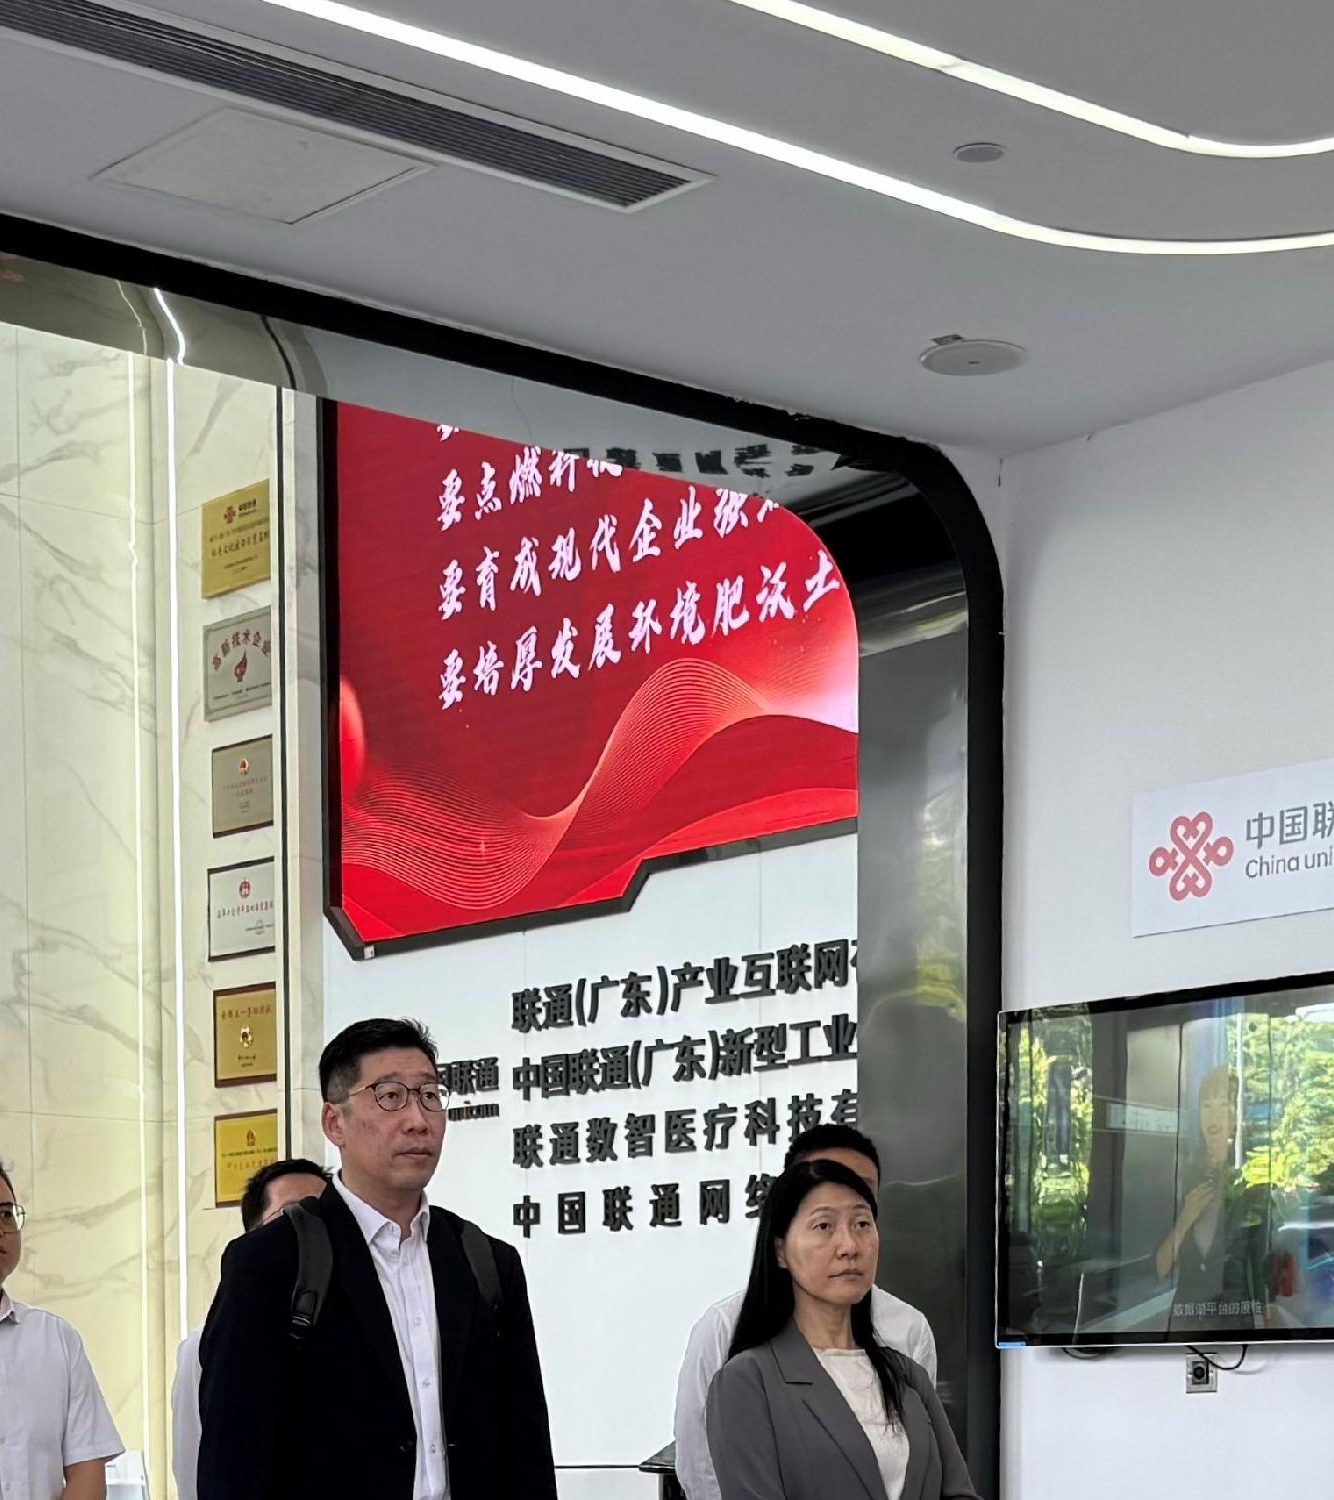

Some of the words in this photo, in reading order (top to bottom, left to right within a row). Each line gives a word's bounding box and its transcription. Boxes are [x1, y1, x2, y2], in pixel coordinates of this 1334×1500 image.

[438, 549, 841, 710] 要培厚发展环境肥沃土
[1245, 854, 1300, 879] China
[512, 938, 858, 1033] 联通(广东)产业互联网
